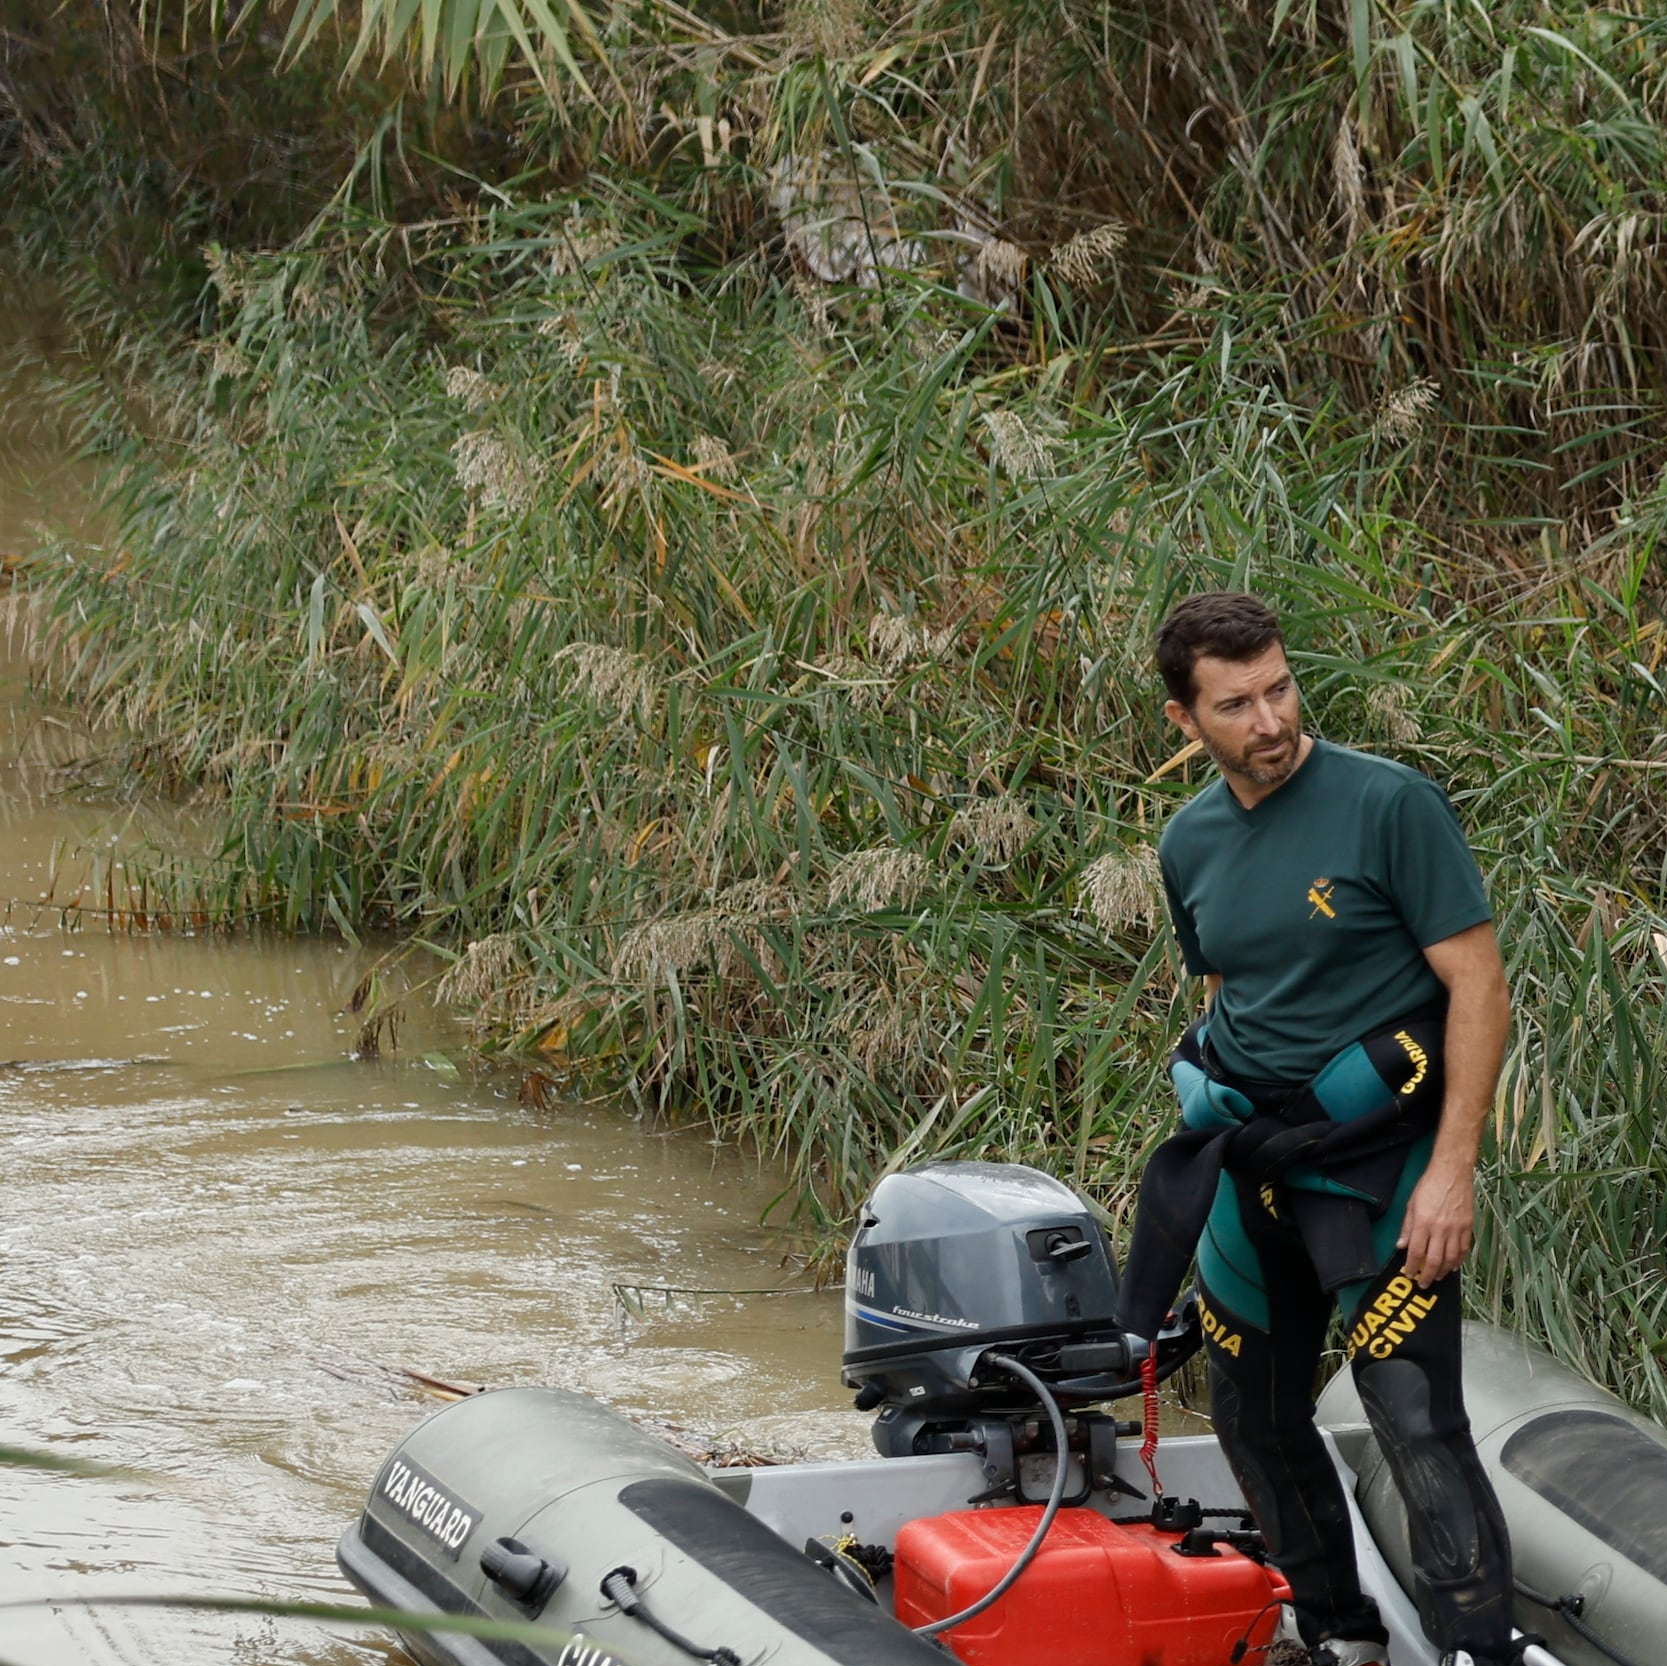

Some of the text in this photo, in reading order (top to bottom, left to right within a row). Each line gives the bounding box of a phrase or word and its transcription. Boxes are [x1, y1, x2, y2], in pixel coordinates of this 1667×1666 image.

[1394, 1030, 1428, 1094] GUARDIA
[1369, 1295, 1438, 1359] CIVIL
[384, 1461, 472, 1548] VANGUARD
